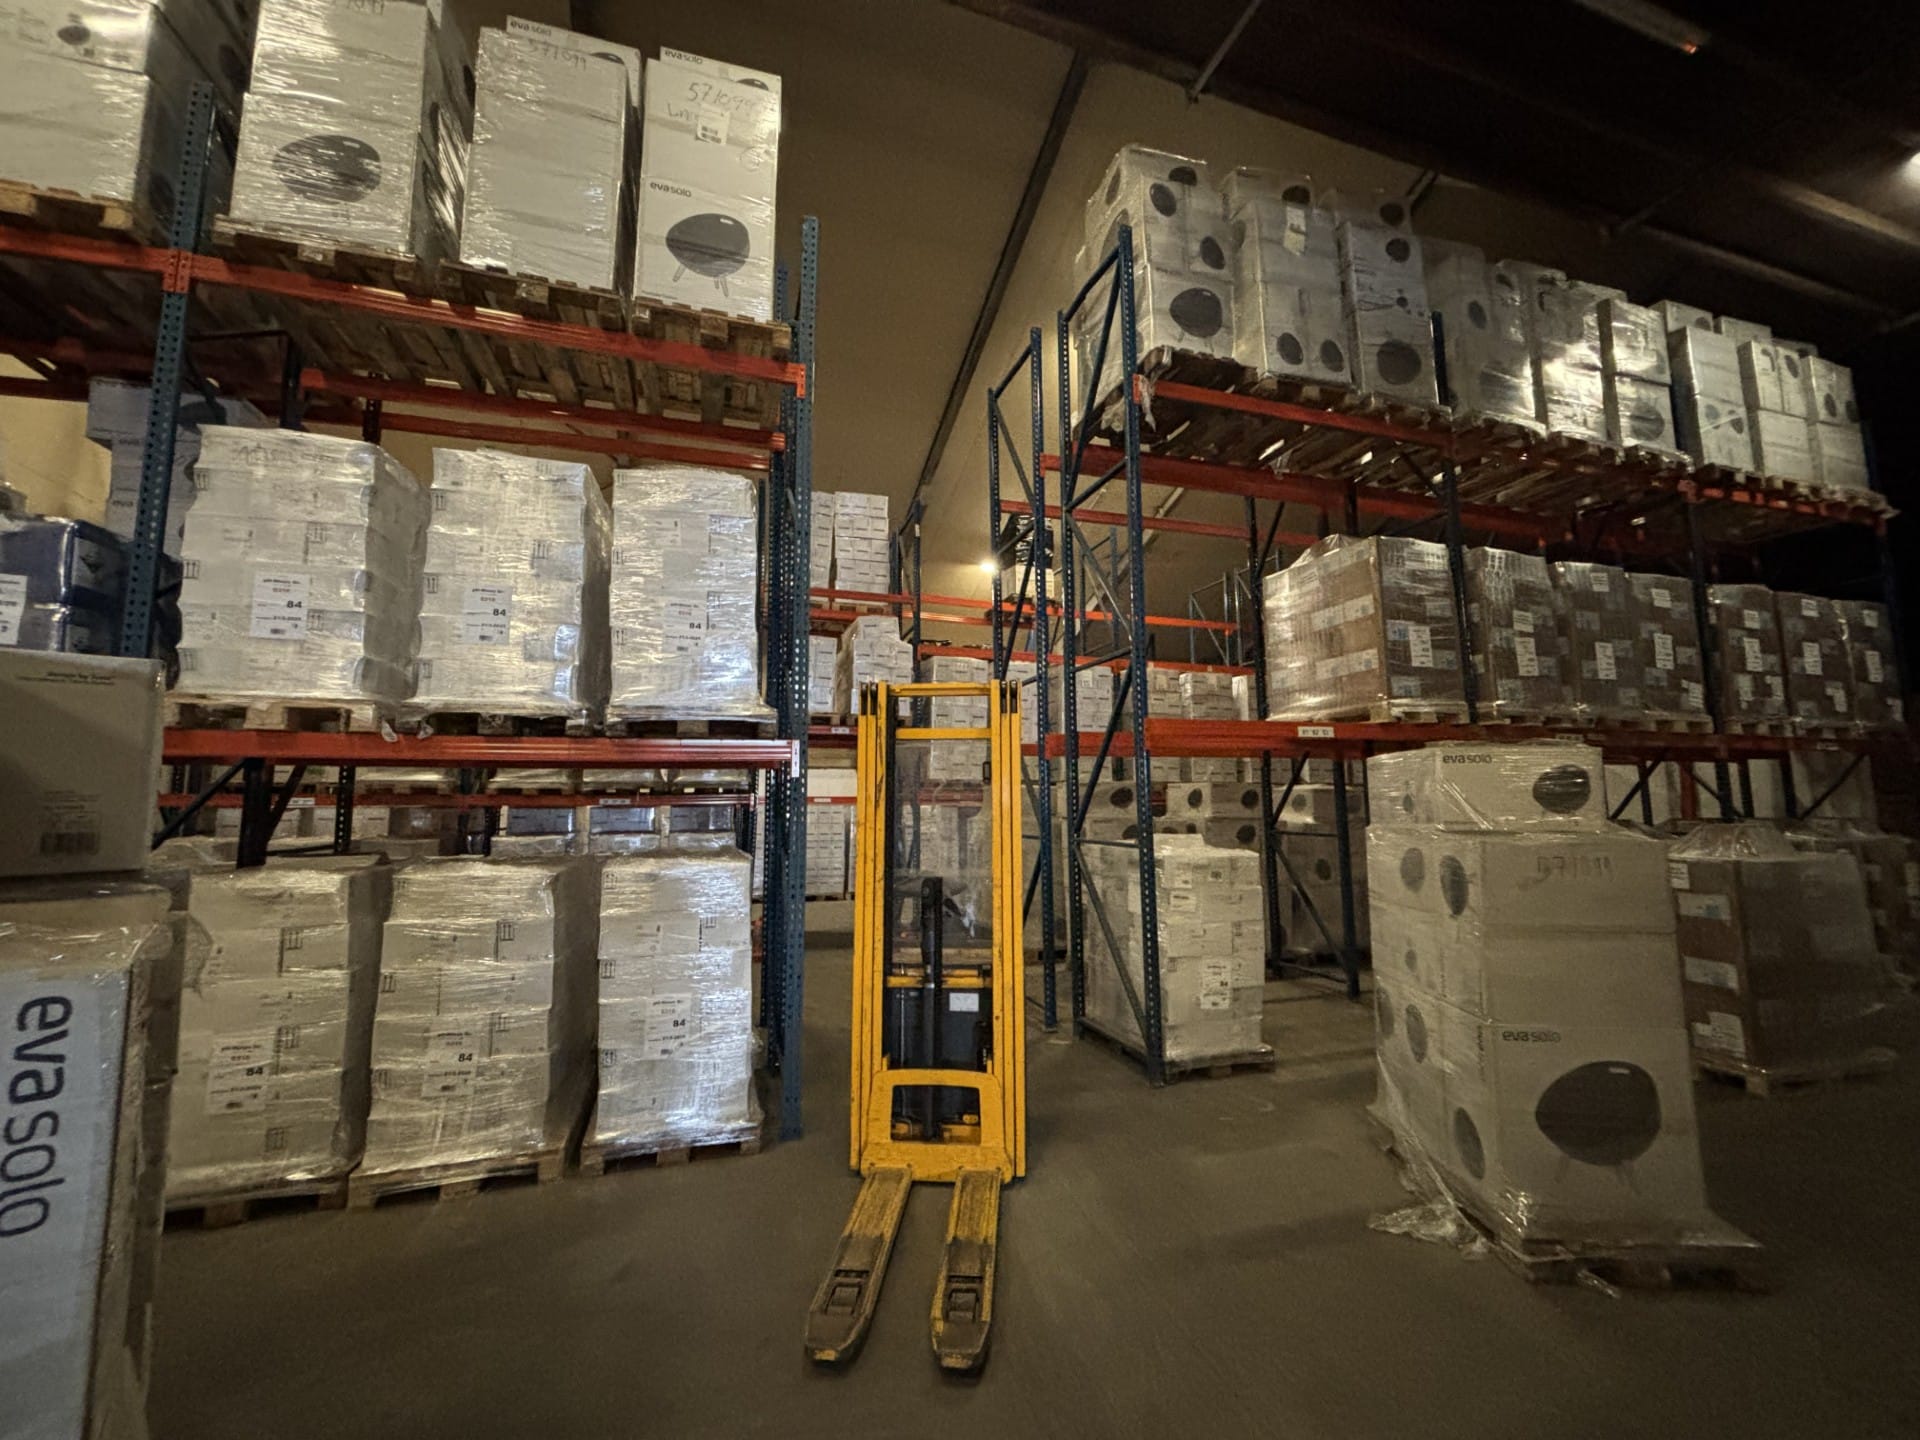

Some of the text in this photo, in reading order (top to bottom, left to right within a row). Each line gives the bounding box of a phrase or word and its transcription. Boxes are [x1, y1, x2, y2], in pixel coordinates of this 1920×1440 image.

[286, 600, 302, 609] 84
[493, 608, 506, 617] 84
[689, 622, 702, 630] 84
[672, 1018, 686, 1028] 84
[458, 1053, 473, 1062] 84
[246, 1066, 264, 1076] 84
